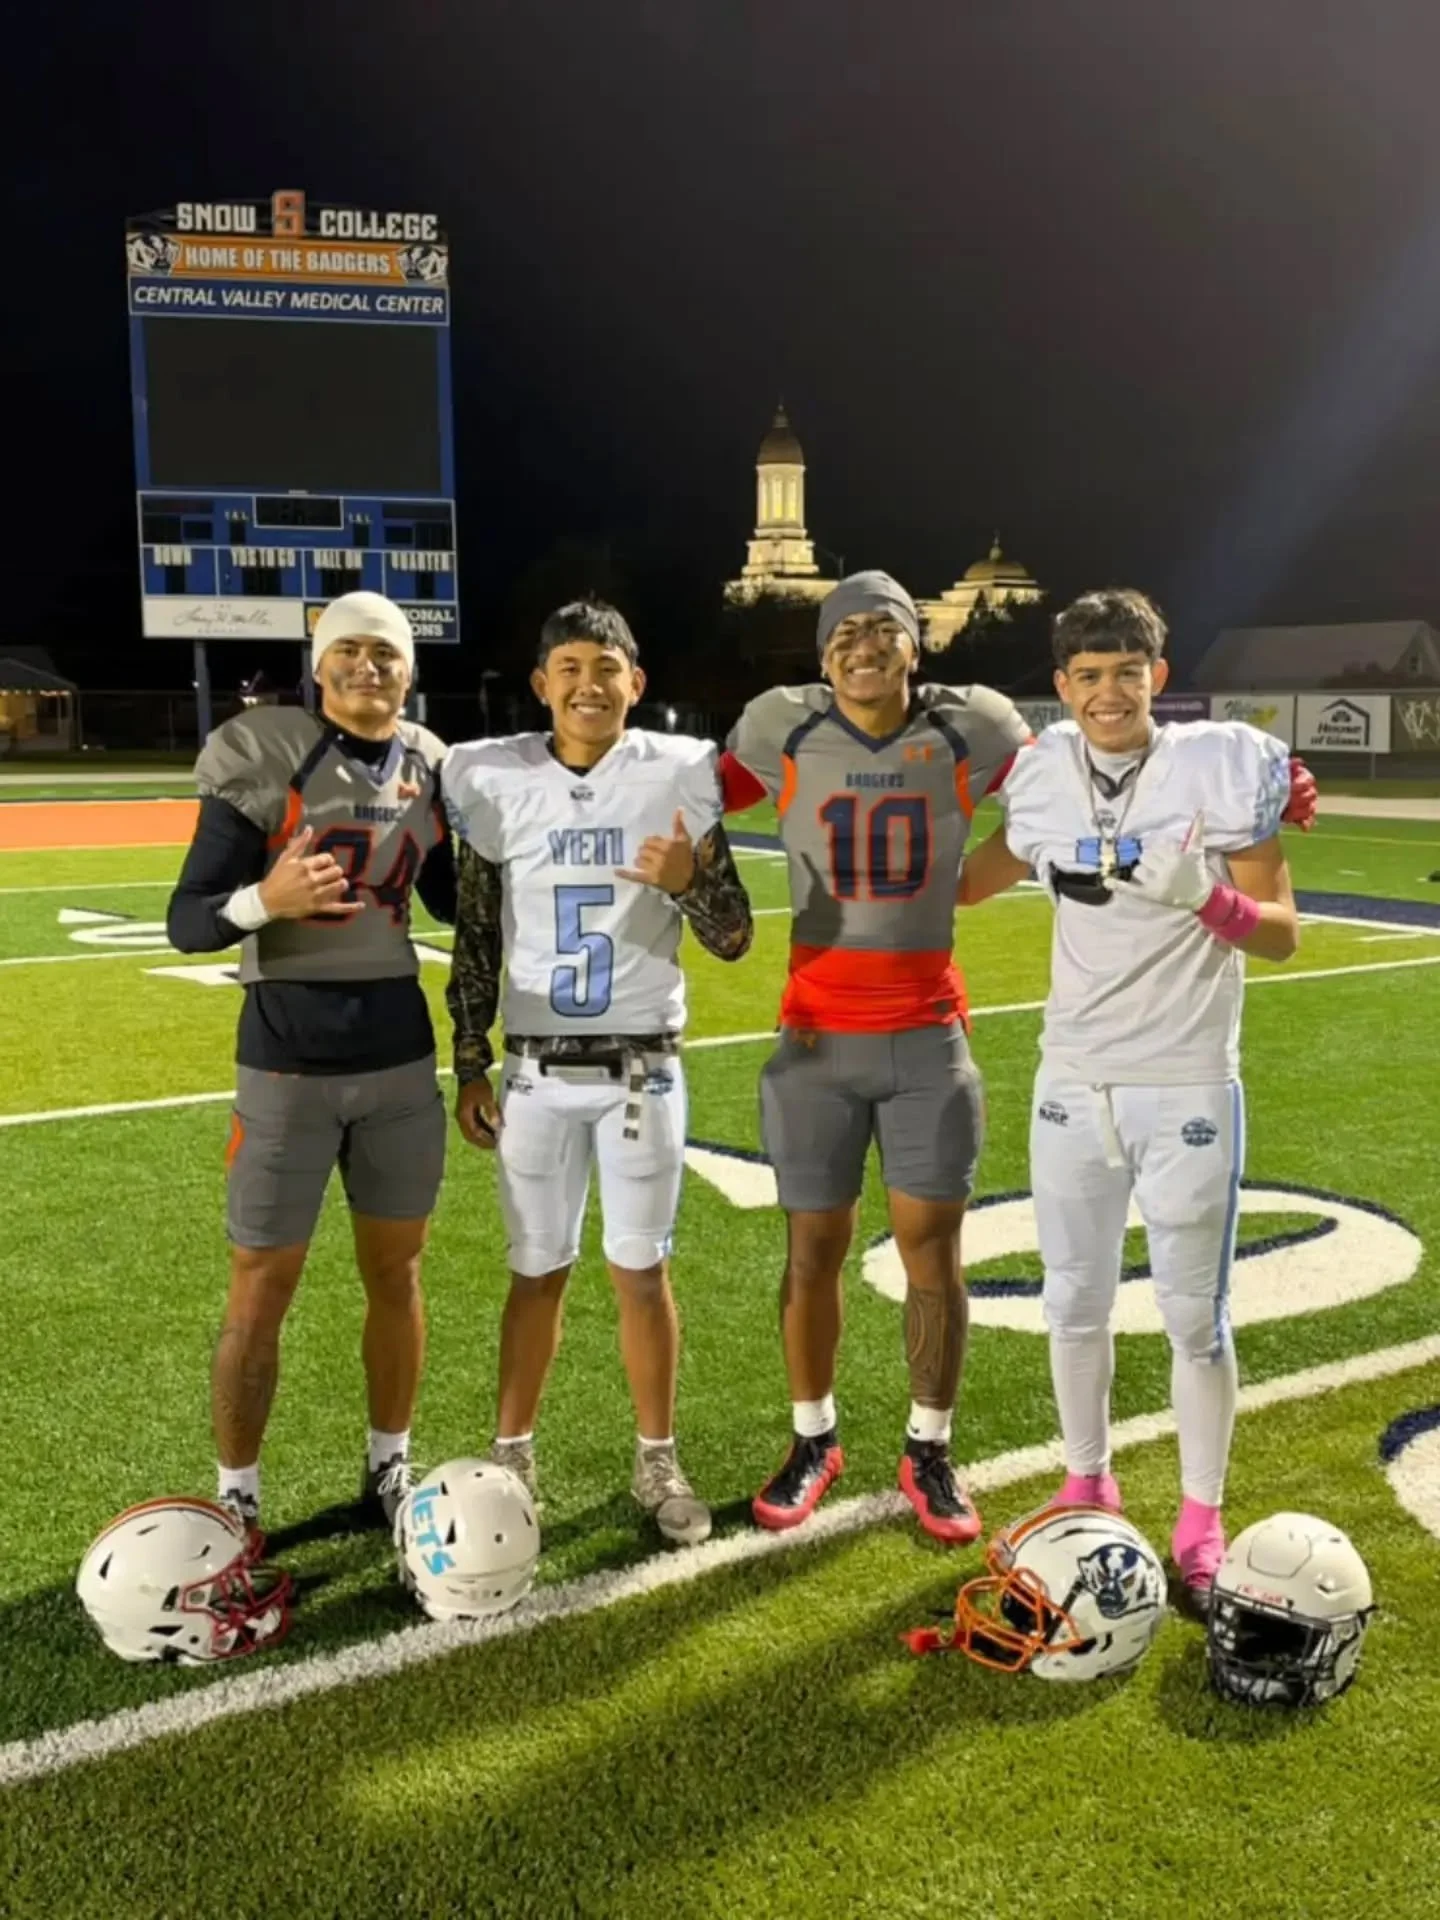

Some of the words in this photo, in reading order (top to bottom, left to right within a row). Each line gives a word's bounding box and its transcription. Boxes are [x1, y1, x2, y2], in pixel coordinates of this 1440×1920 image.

[176, 203, 256, 233] SNOW
[319, 209, 439, 241] COLLEGE
[185, 247, 237, 269] HOME
[243, 248, 265, 270] OF
[270, 249, 302, 271] THE
[306, 250, 391, 274] BADGERS
[134, 285, 217, 306] CENTRAL
[221, 288, 287, 308] VALLEY
[290, 290, 371, 312] MEDICAL
[375, 294, 445, 314] CENTER
[548, 827, 624, 866] YETI
[817, 794, 933, 902] 10
[550, 884, 614, 1017] 5
